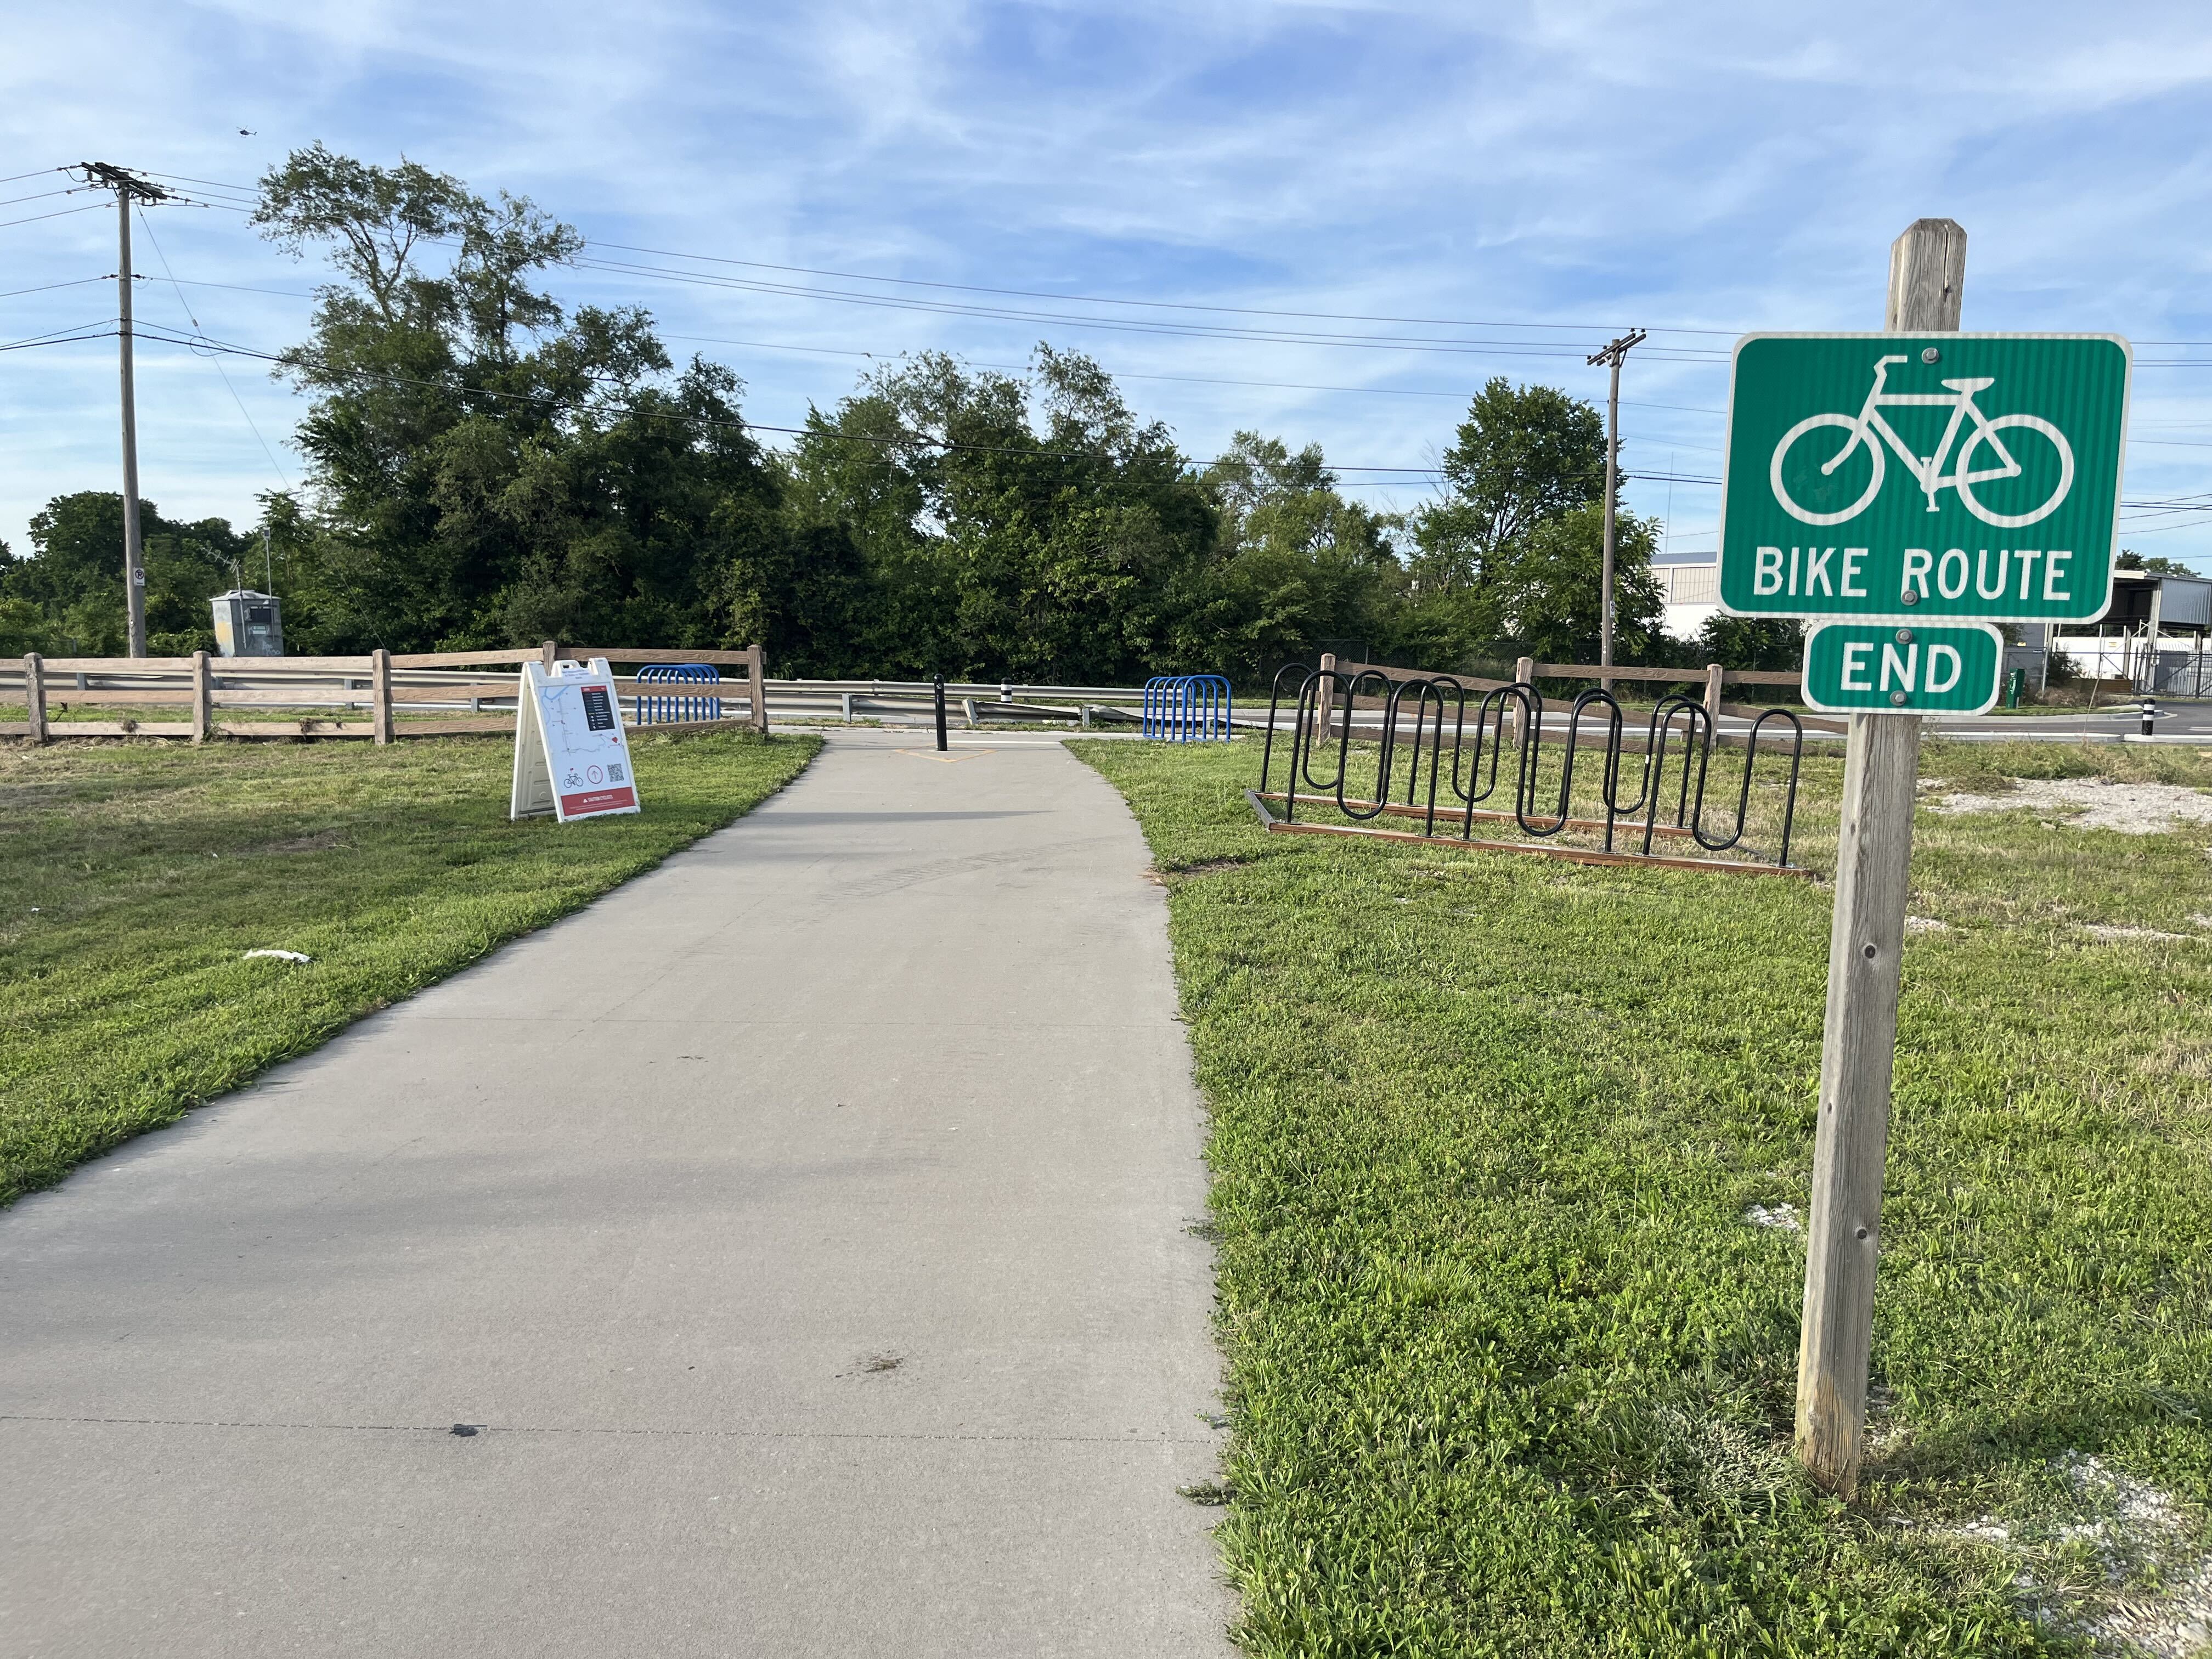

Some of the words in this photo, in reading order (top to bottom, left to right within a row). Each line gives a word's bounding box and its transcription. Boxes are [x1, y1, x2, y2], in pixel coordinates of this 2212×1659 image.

[1753, 546, 1869, 597] BIKE
[1900, 549, 2072, 600] ROUTE
[1841, 642, 1961, 693] END
